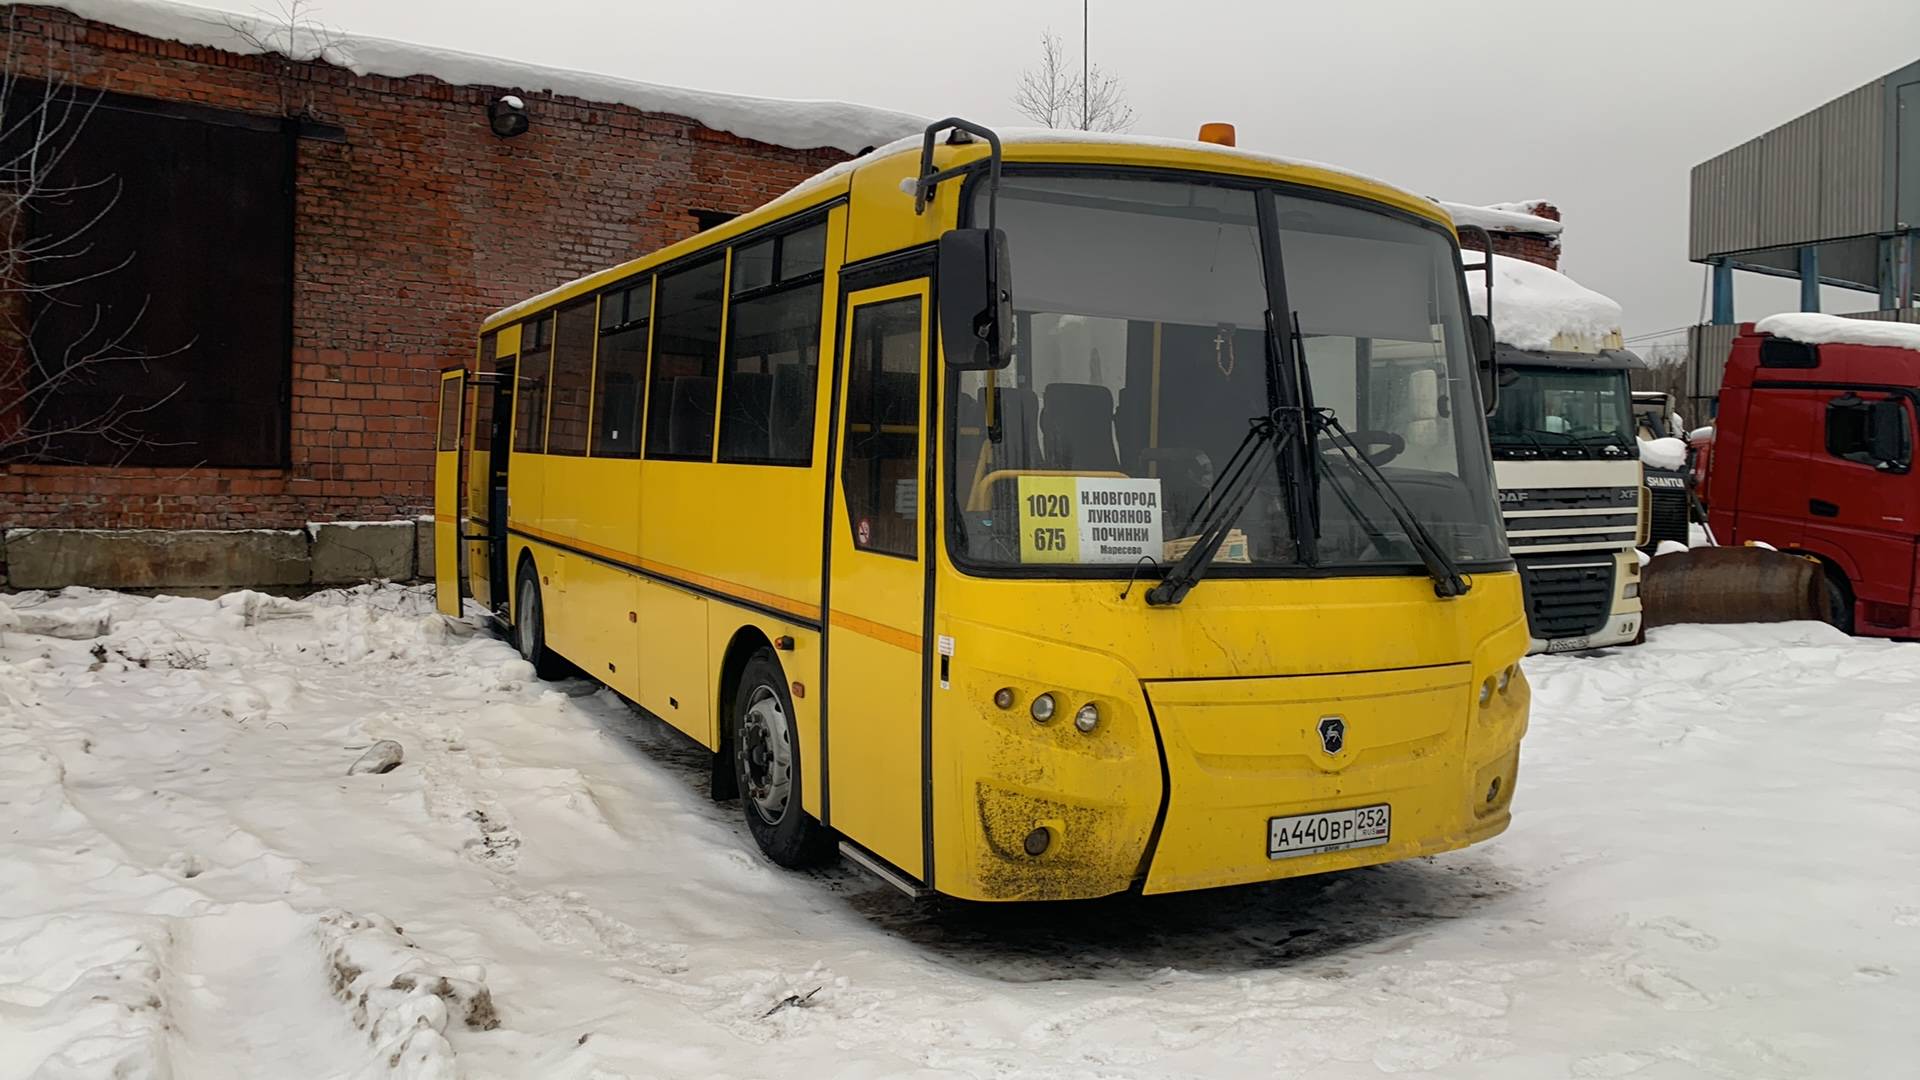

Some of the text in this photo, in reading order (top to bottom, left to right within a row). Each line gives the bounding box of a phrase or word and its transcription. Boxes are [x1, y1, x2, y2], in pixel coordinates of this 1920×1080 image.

[1647, 476, 1685, 488] SHANTUI
[1081, 491, 1157, 508] Н.НОВГОРОД
[1620, 490, 1638, 499] XF
[1027, 495, 1070, 517] 1020
[1088, 509, 1152, 524] ЛУКОЯНОВ
[1034, 528, 1066, 551] 675
[1092, 527, 1149, 542] ПОЧИНКИ
[1100, 545, 1142, 555] Маресево
[1357, 809, 1385, 829] 252
